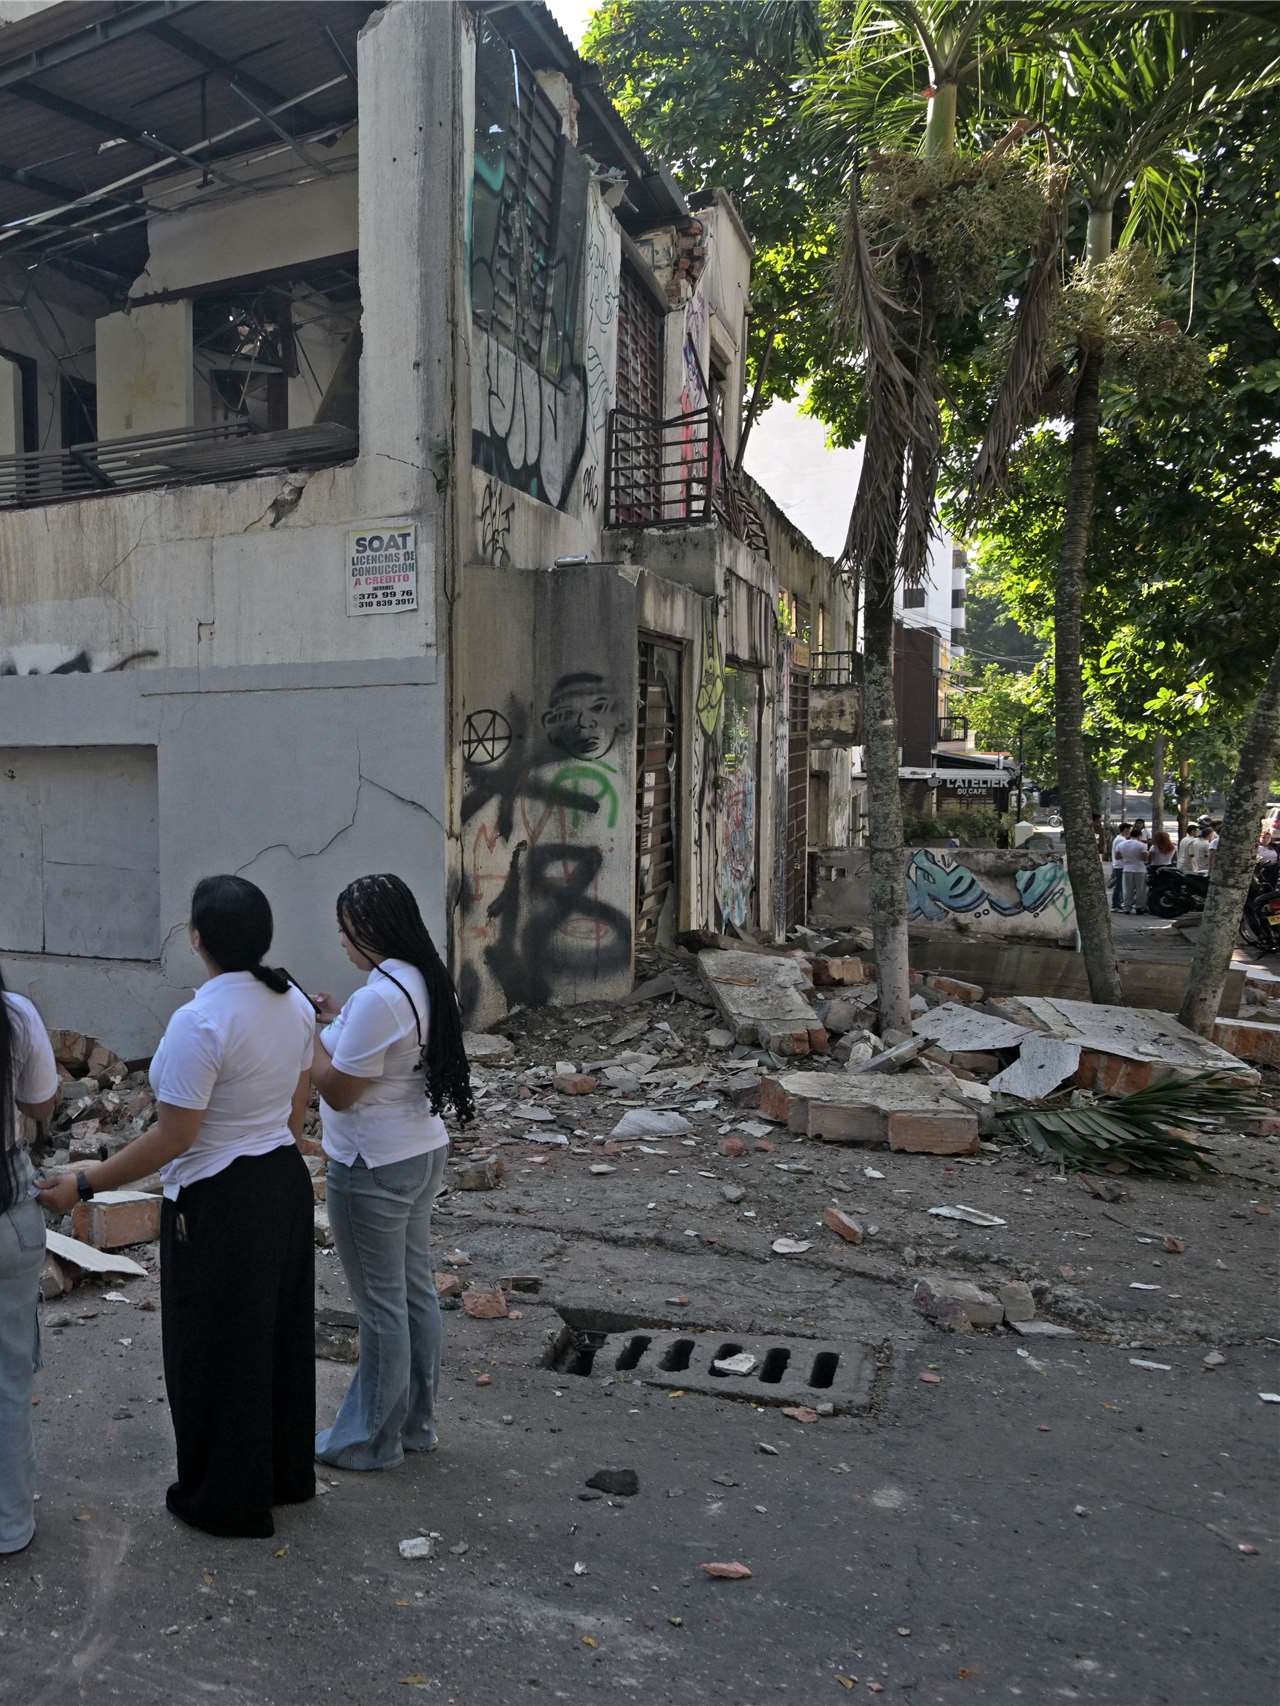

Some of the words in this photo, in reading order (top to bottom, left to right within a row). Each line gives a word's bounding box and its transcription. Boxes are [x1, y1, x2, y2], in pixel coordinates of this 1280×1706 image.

[355, 533, 411, 554] SOAT
[352, 552, 400, 566] LICENCIAS
[404, 551, 415, 562] DE
[354, 578, 361, 586] A
[946, 777, 1009, 788] L'ATELIER
